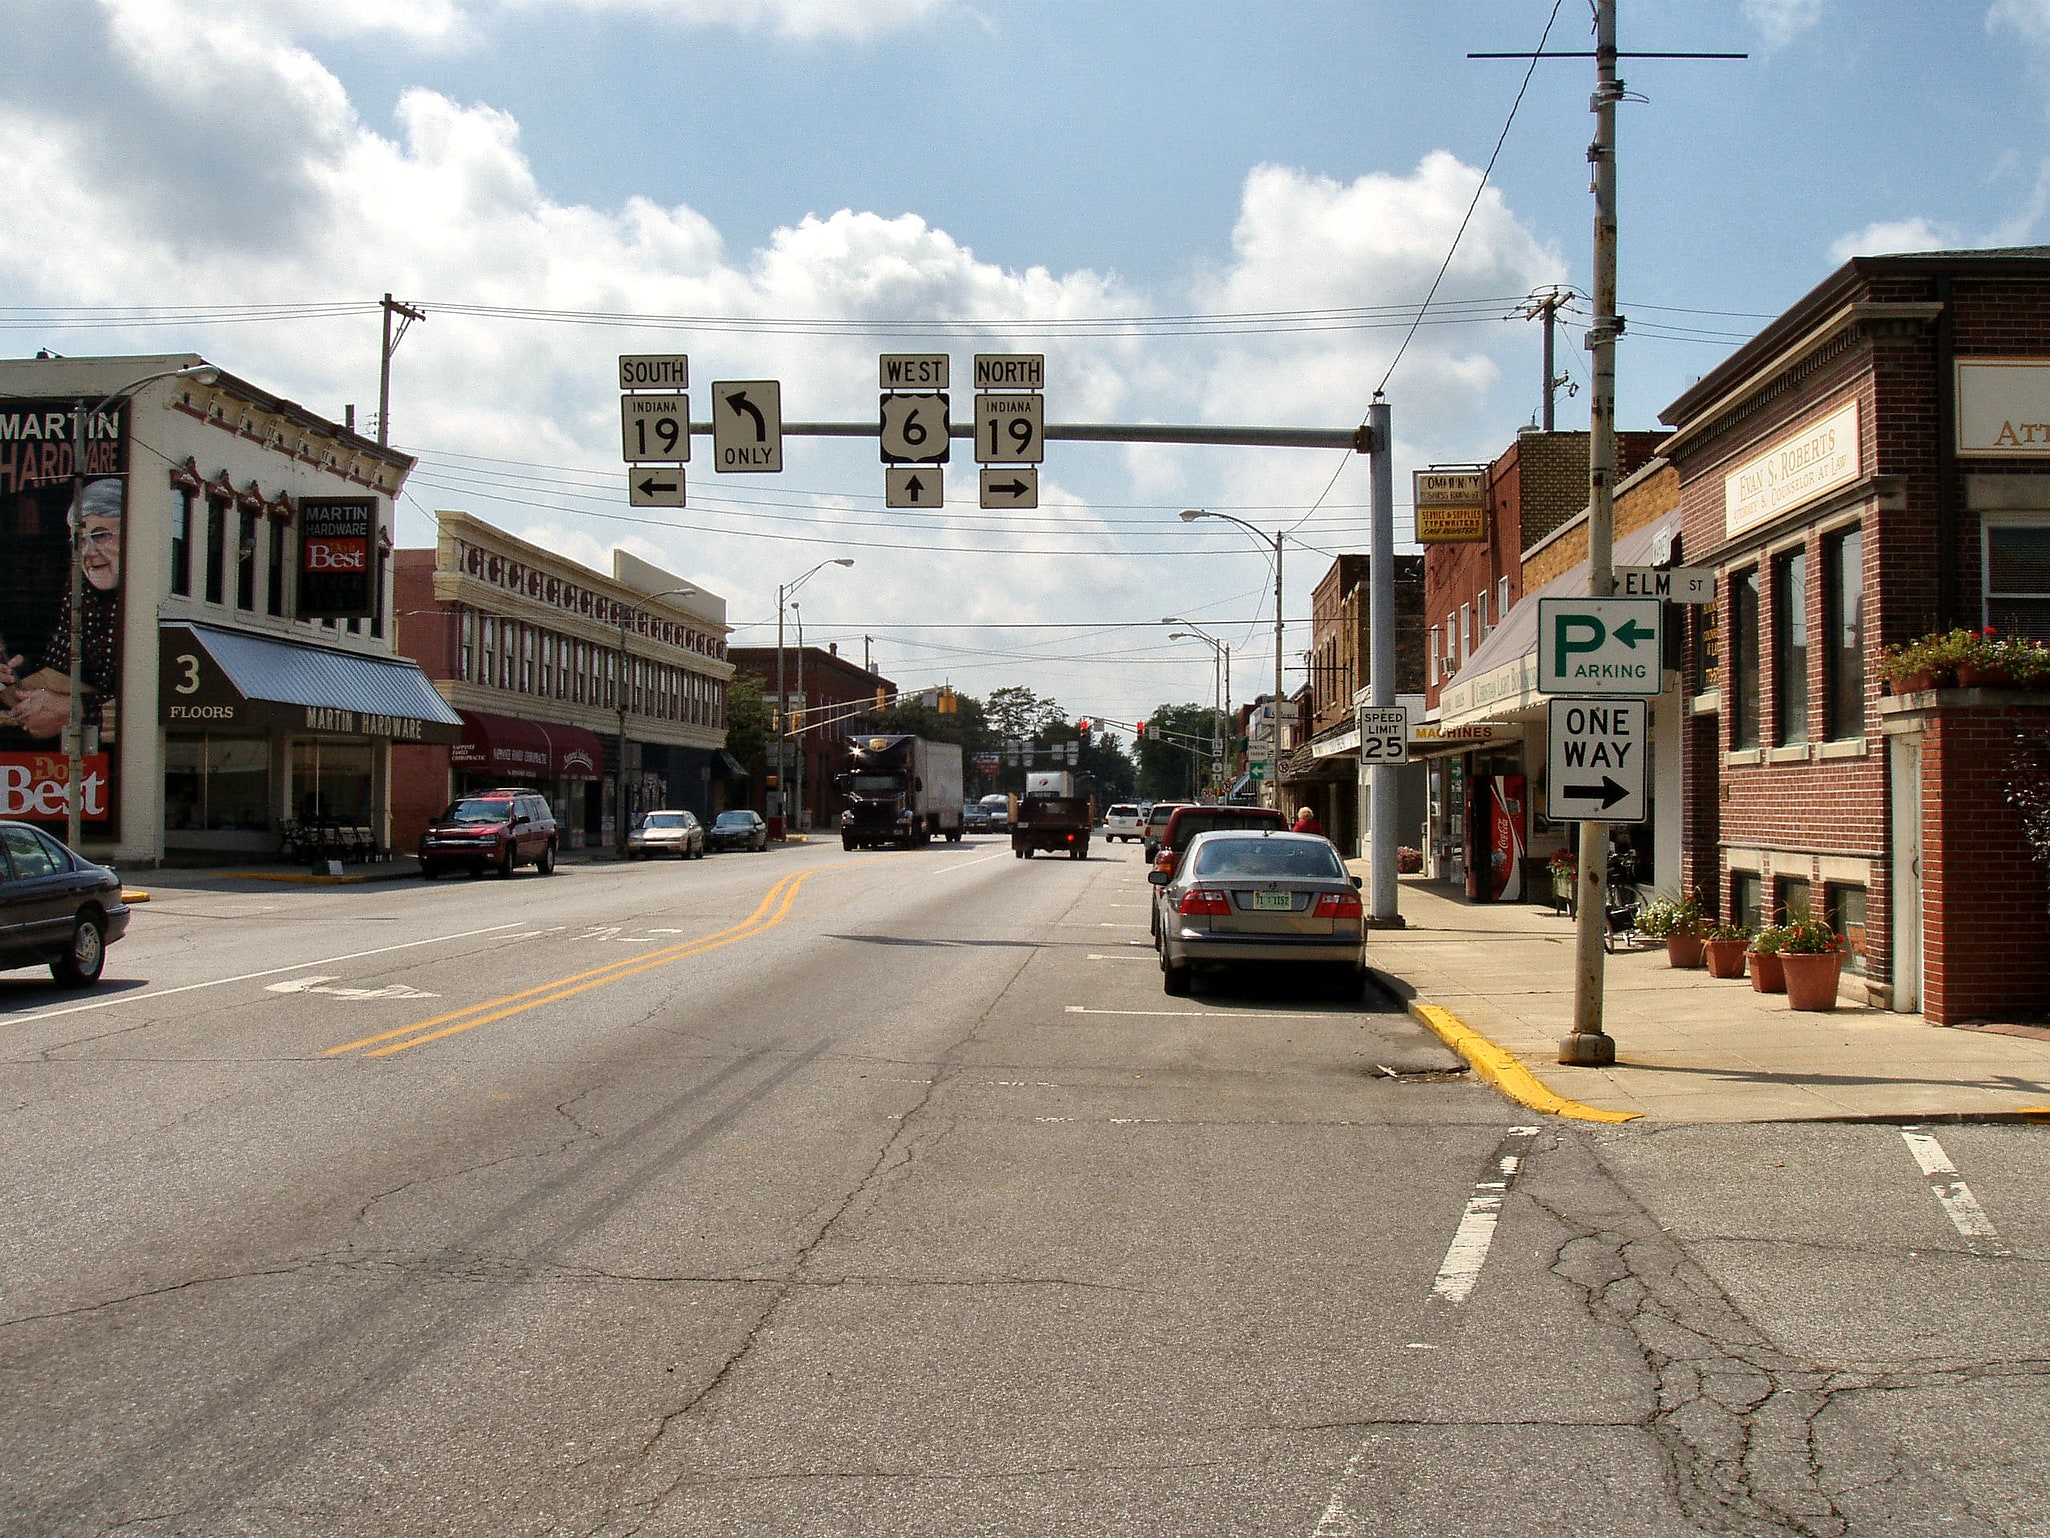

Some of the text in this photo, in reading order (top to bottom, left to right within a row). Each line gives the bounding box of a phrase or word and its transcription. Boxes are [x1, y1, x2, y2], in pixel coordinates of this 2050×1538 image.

[623, 361, 685, 383] SOUTH
[887, 361, 941, 382] WEST
[978, 360, 1041, 383] NORTH
[632, 402, 677, 413] INDIANA
[986, 402, 1032, 413] INDIANA
[634, 418, 680, 455] 19
[902, 409, 927, 446] 6
[988, 418, 1034, 455] 19
[725, 448, 773, 465] ONLY
[1740, 428, 1836, 502] EVAN S. ROBERTS
[1772, 473, 1815, 506] COUNSELOR
[1818, 465, 1829, 481] AT
[306, 506, 368, 521] MARTIN
[1422, 511, 1445, 519] SERVICE
[1453, 510, 1481, 519] SUPPLIES
[305, 523, 367, 536] HARDWARE
[308, 544, 364, 569] Best
[1626, 573, 1703, 595] ELM ST
[175, 654, 200, 695] 3
[170, 706, 234, 719] FLOORS
[306, 707, 422, 740] MARTIN HARDWARE
[1364, 713, 1402, 723] SPEED
[1566, 708, 1629, 735] ONE
[1369, 725, 1398, 733] LIMIT
[1415, 726, 1492, 739] MACHINES
[1365, 737, 1402, 758] 25
[1564, 742, 1632, 768] WAY
